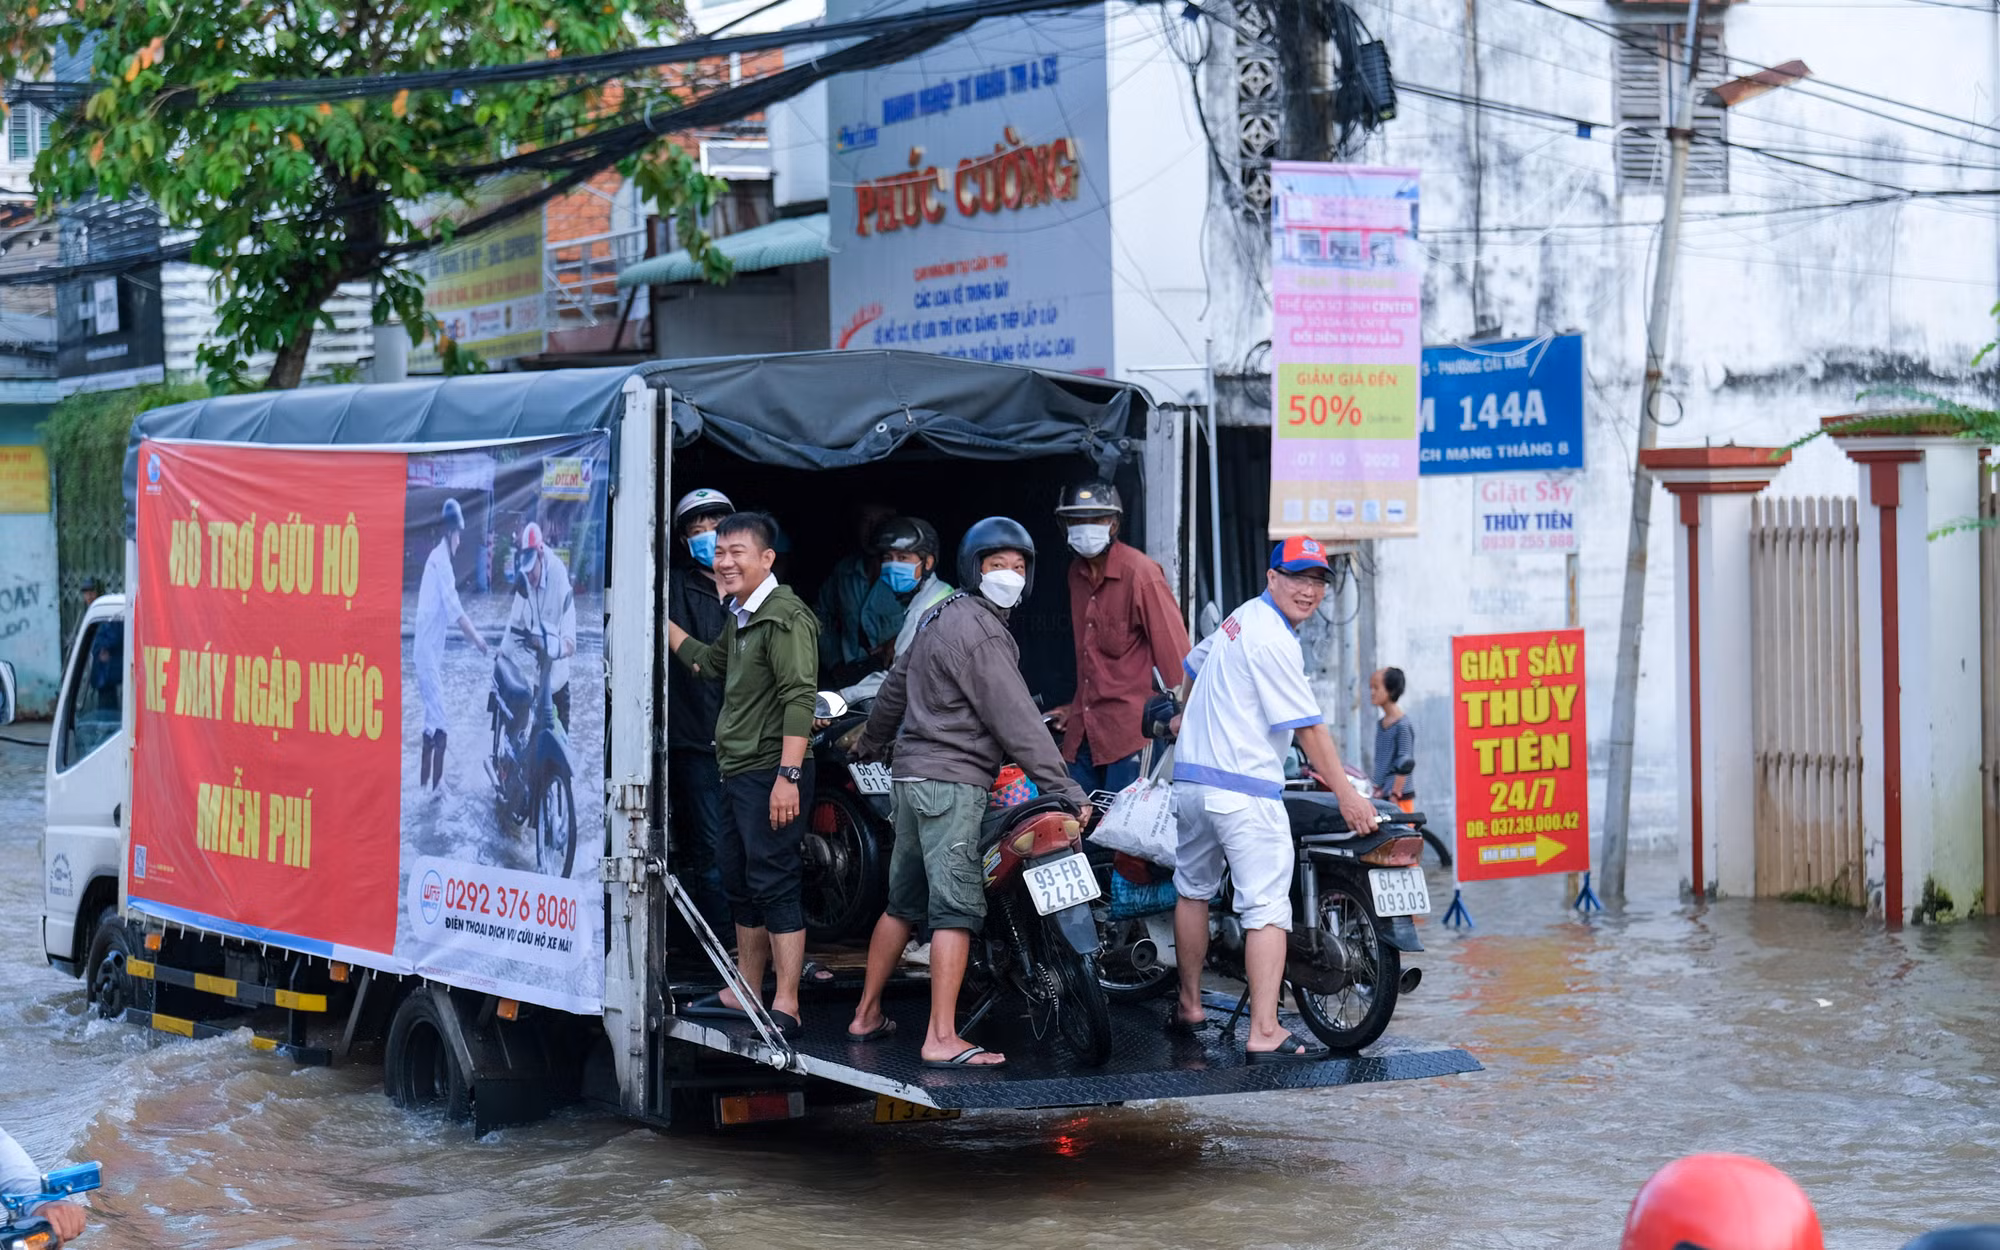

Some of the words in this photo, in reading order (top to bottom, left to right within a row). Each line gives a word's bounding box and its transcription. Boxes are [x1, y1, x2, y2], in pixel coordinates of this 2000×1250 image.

[856, 146, 947, 236] PHÚC
[1297, 368, 1334, 386] GIẢM
[1338, 371, 1364, 387] GIÁ
[1368, 369, 1397, 387] ĐẾN
[1288, 394, 1362, 426] 50%
[1459, 389, 1548, 431] 144A
[1446, 445, 1493, 463] MẠNG
[1497, 440, 1552, 459] THÁNG
[1558, 441, 1569, 456] 8
[1535, 509, 1574, 531] TIÊN
[169, 499, 202, 588] HỖ
[208, 512, 256, 604] TRỢ
[262, 512, 315, 595] CỨU
[322, 512, 359, 610] HỘ
[1460, 644, 1521, 685] GIẶT
[1528, 635, 1577, 678] SẤY
[144, 646, 171, 713] XE
[174, 641, 228, 721] MÁY
[234, 647, 301, 742] NGẬP
[309, 653, 383, 740] NƯỚC
[1460, 678, 1578, 729] THỦY
[1472, 729, 1571, 776] TIÊN
[1490, 777, 1556, 814] 24/7
[197, 766, 261, 860] MIỄN
[268, 788, 313, 869] PHÍ
[1491, 811, 1579, 836] 037.39.000.42
[1034, 860, 1082, 890] 93-FB
[1378, 871, 1416, 891] 64-F1
[445, 878, 490, 914] 0292
[497, 886, 530, 922] 376
[536, 893, 577, 932] 8080
[1042, 879, 1090, 910] 2426
[1377, 891, 1426, 913] 093.03
[445, 915, 464, 934] ĐIỆN
[466, 919, 487, 939] THOẠI
[488, 924, 506, 941] DỊCH
[507, 928, 517, 944] VỤ
[517, 927, 534, 945] CỨU
[534, 931, 546, 951] HỘ
[547, 936, 558, 950] XE
